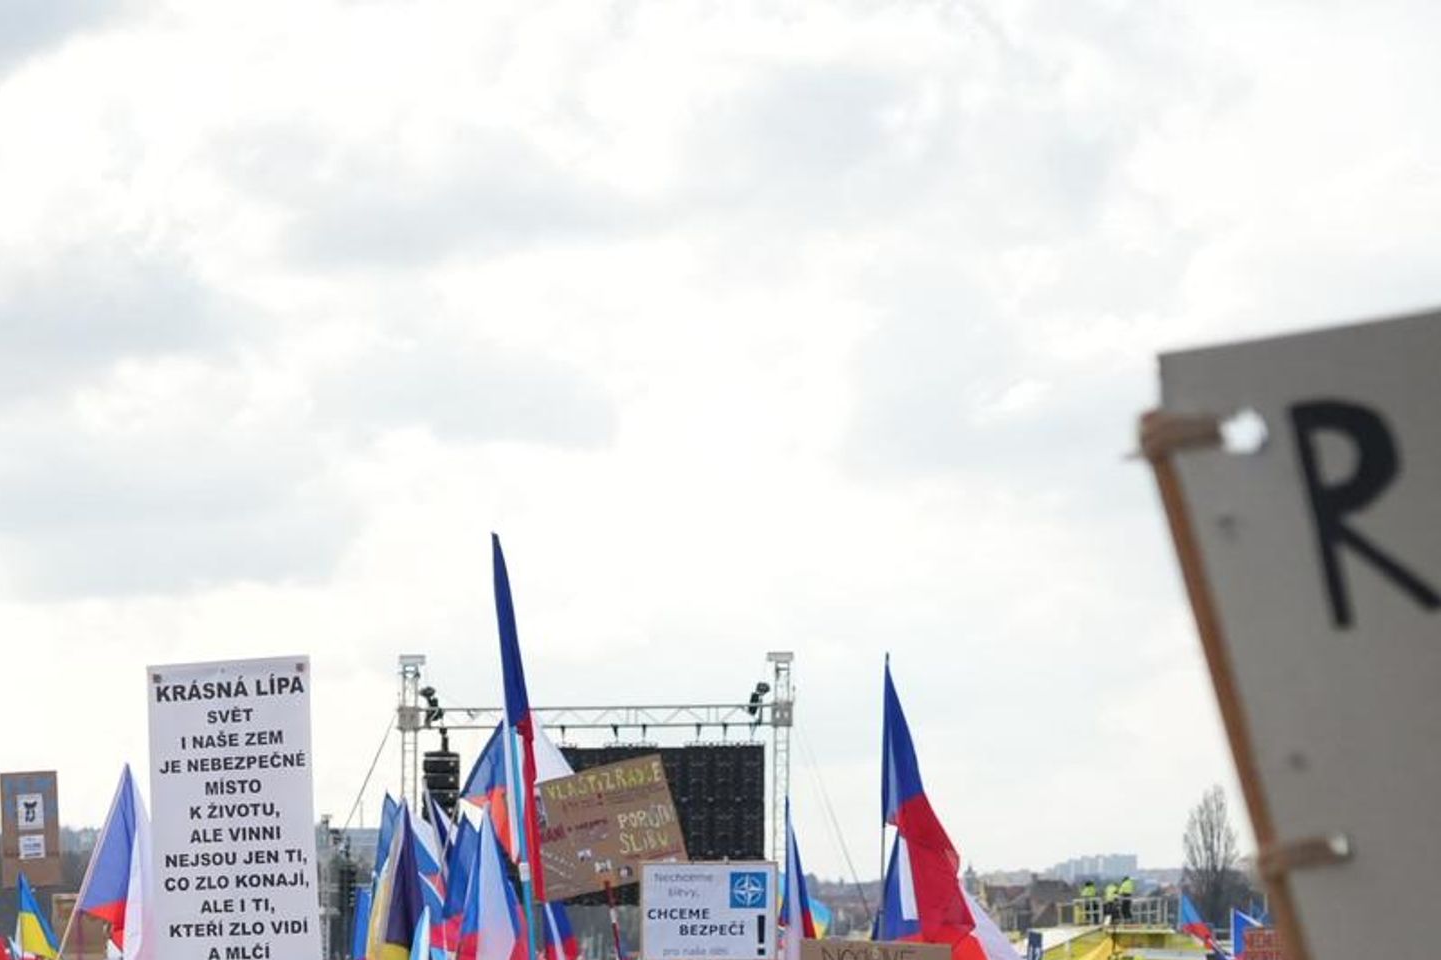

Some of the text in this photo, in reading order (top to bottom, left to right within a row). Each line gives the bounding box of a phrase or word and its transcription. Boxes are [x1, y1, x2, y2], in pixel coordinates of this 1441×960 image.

[156, 674, 304, 702] KRÁSNÁ LÍPA
[207, 706, 253, 724] SVĚT
[181, 730, 283, 749] I NAŠE ZEM
[160, 751, 306, 774] JE NEBEZPEČNÉ
[205, 778, 261, 795] MÍSTO
[190, 802, 280, 819] K ŽIVOTU,
[190, 826, 280, 843] ALE VINNI
[165, 849, 307, 868] NEJSOU JEN TI,
[165, 869, 309, 891] CO ZLO KONAJÍ,
[201, 898, 275, 914] ALE I TI,
[648, 908, 711, 920] CHCEME
[169, 917, 308, 938] KTEŘÍ ZLO VIDÍ
[679, 921, 745, 937] BEZPEČÍ
[208, 942, 270, 960] A MLČÍ
